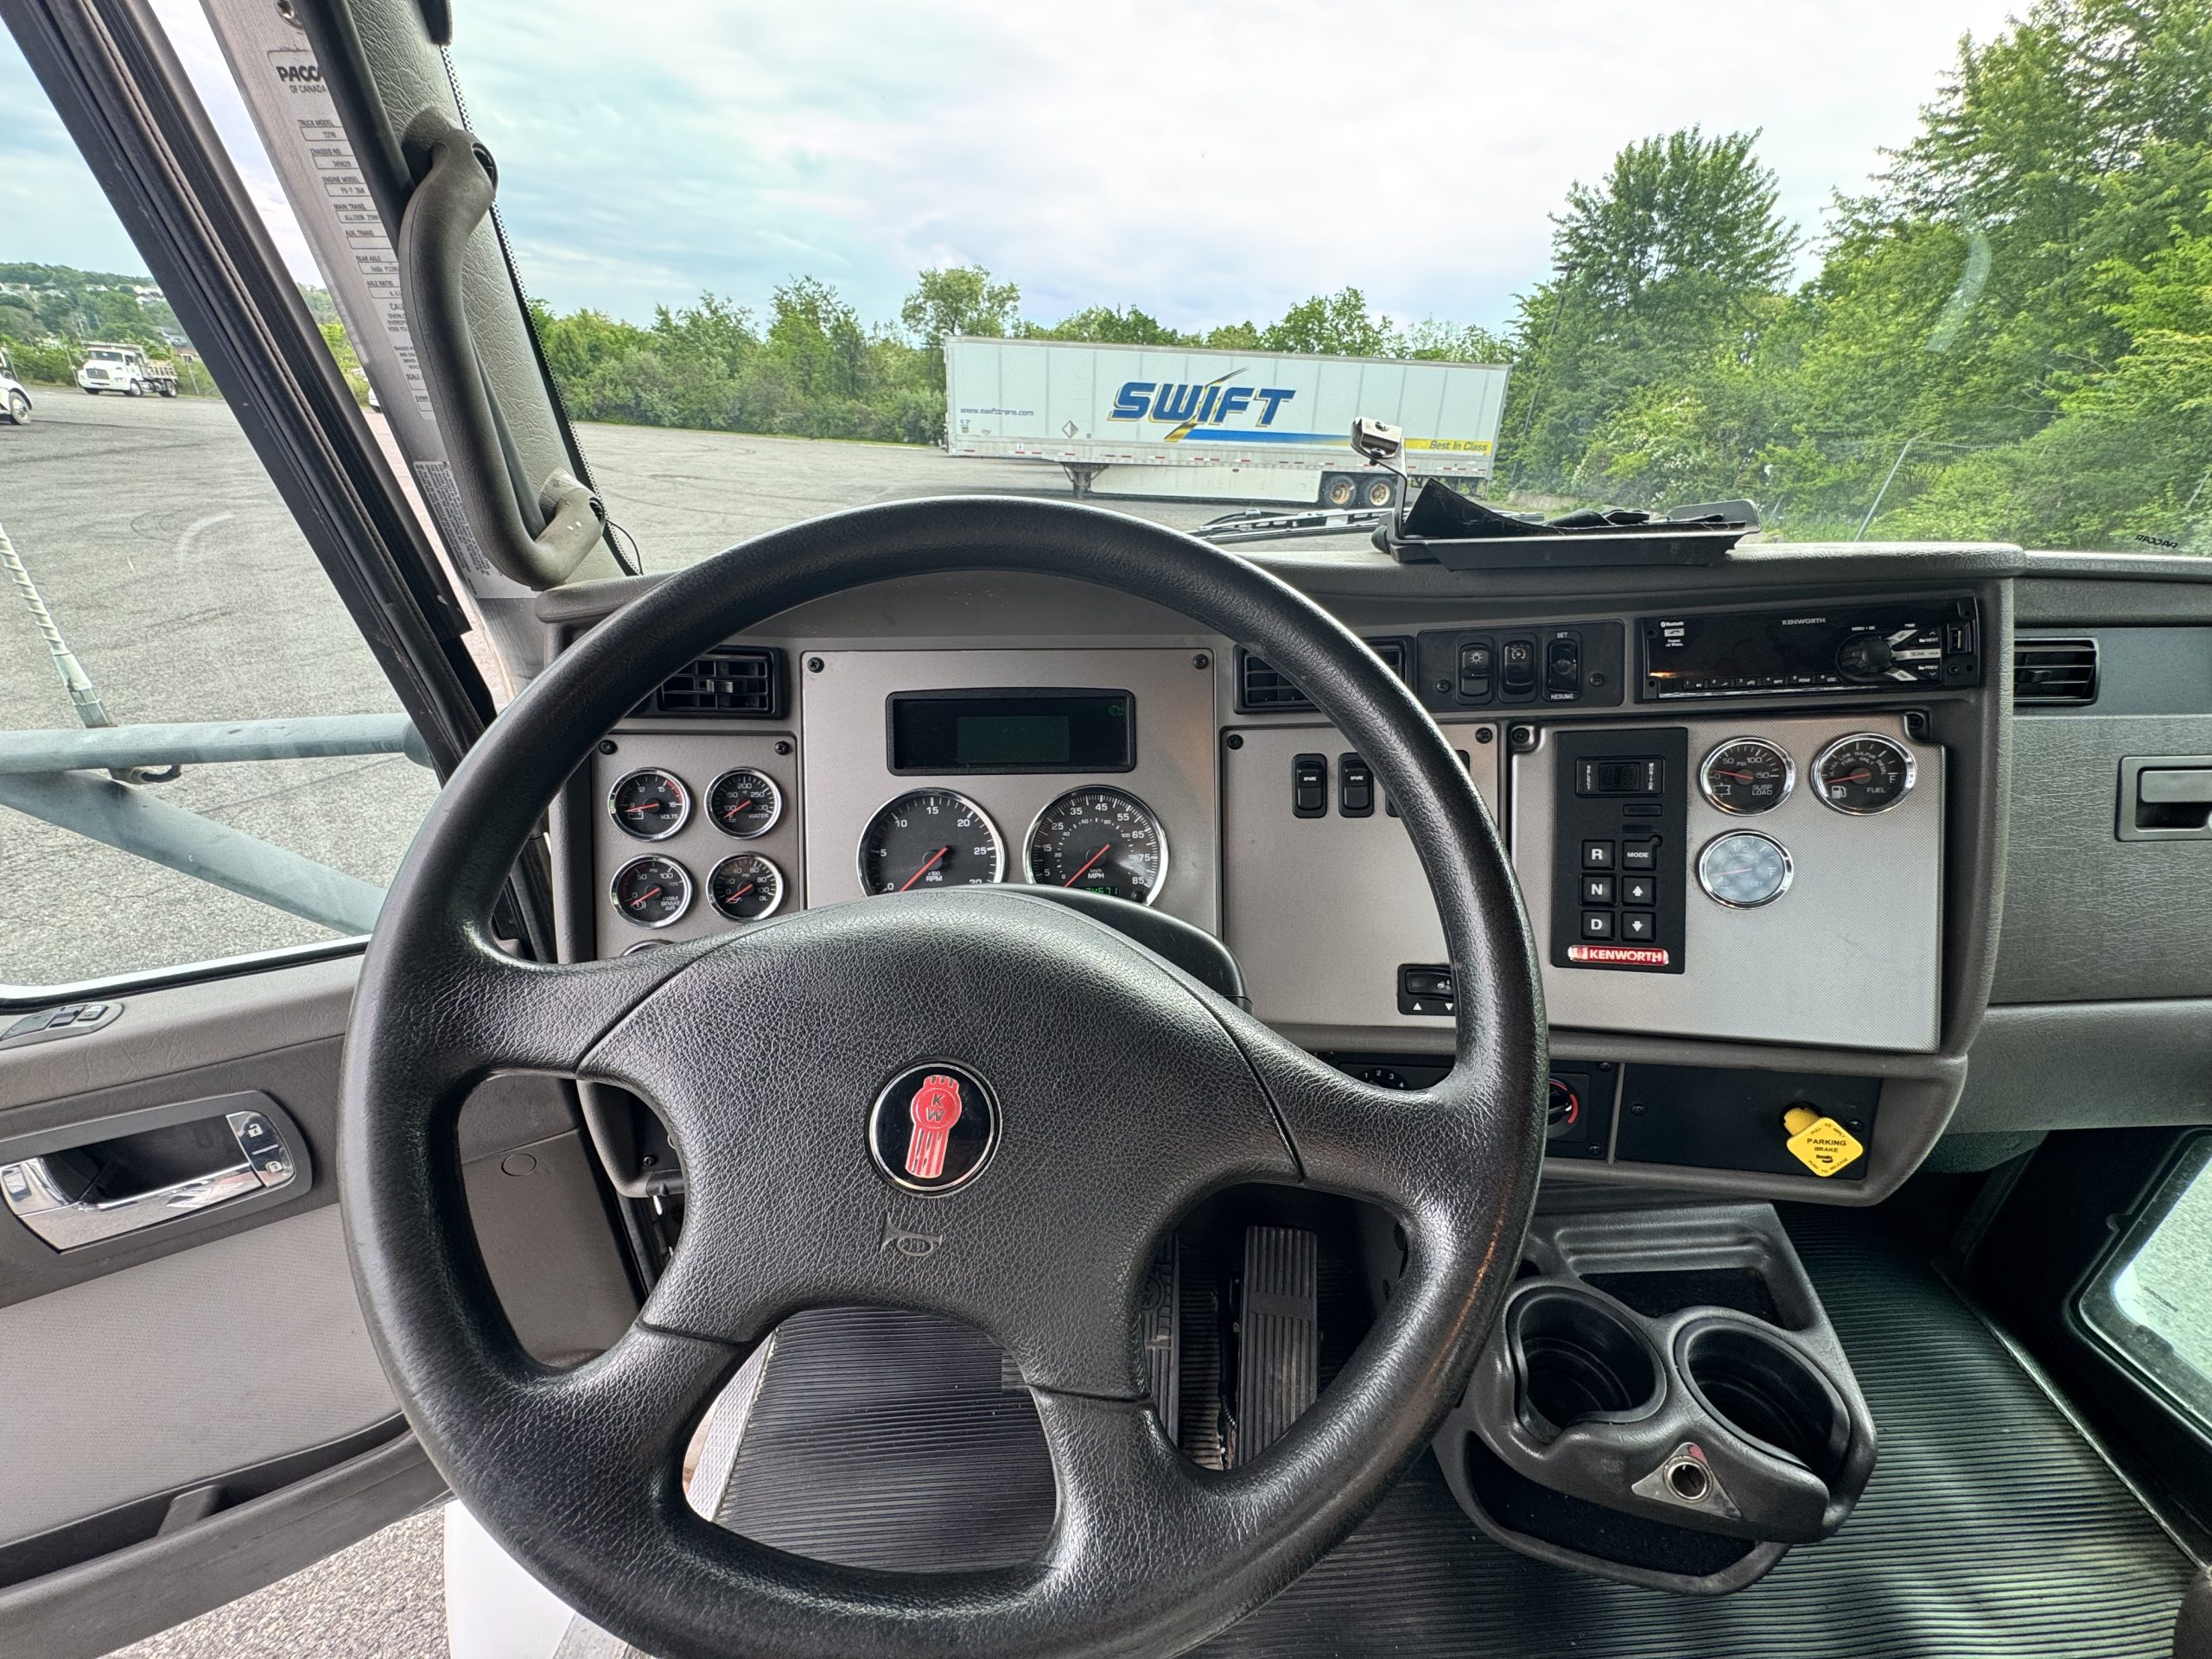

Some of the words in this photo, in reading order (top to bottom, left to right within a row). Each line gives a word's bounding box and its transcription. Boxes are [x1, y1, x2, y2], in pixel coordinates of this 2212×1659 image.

[276, 66, 321, 82] PACC
[289, 85, 298, 93] OF
[299, 85, 327, 93] CANADA
[1108, 381, 1296, 428] SWIFT
[1429, 441, 1451, 449] Best
[1452, 442, 1461, 450] In
[1464, 442, 1488, 451] Class
[1782, 617, 1826, 626] KENWORTH
[926, 806, 939, 815] 15
[895, 819, 907, 828] 10
[1591, 849, 1603, 860] R
[1591, 884, 1603, 895] N
[1591, 918, 1603, 930] D
[1590, 950, 1662, 962] KENWORTH
[932, 1093, 944, 1107] K
[925, 1107, 945, 1122] W
[1829, 1157, 1848, 1170] RELEASE
